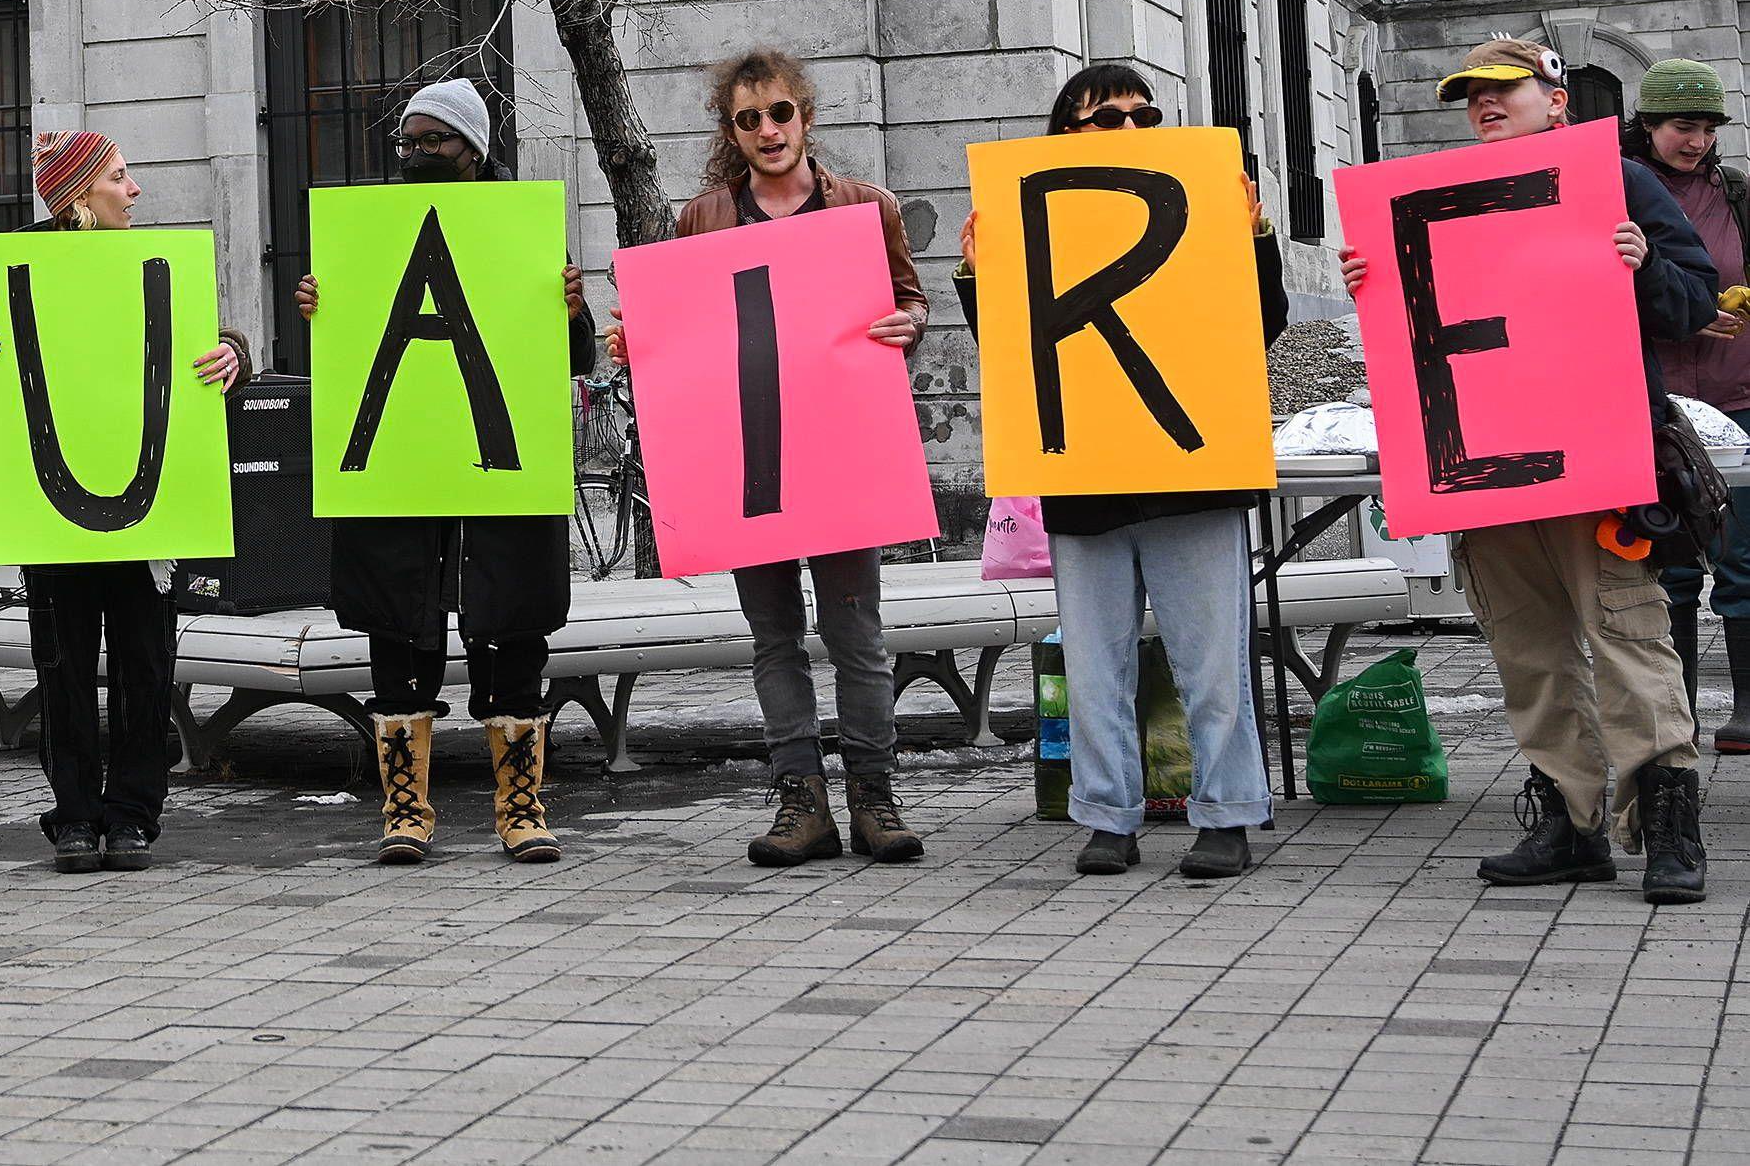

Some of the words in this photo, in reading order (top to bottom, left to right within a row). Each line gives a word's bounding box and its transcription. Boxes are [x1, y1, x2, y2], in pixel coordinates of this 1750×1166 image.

[7, 258, 172, 532] U
[243, 398, 290, 410] SOUNDBOKS
[340, 205, 522, 472] A
[734, 266, 782, 518] I
[1020, 167, 1205, 454] R
[1391, 168, 1565, 494] E
[233, 461, 279, 473] SOUNDBOKS
[1342, 778, 1403, 787] DOLLARAMA
